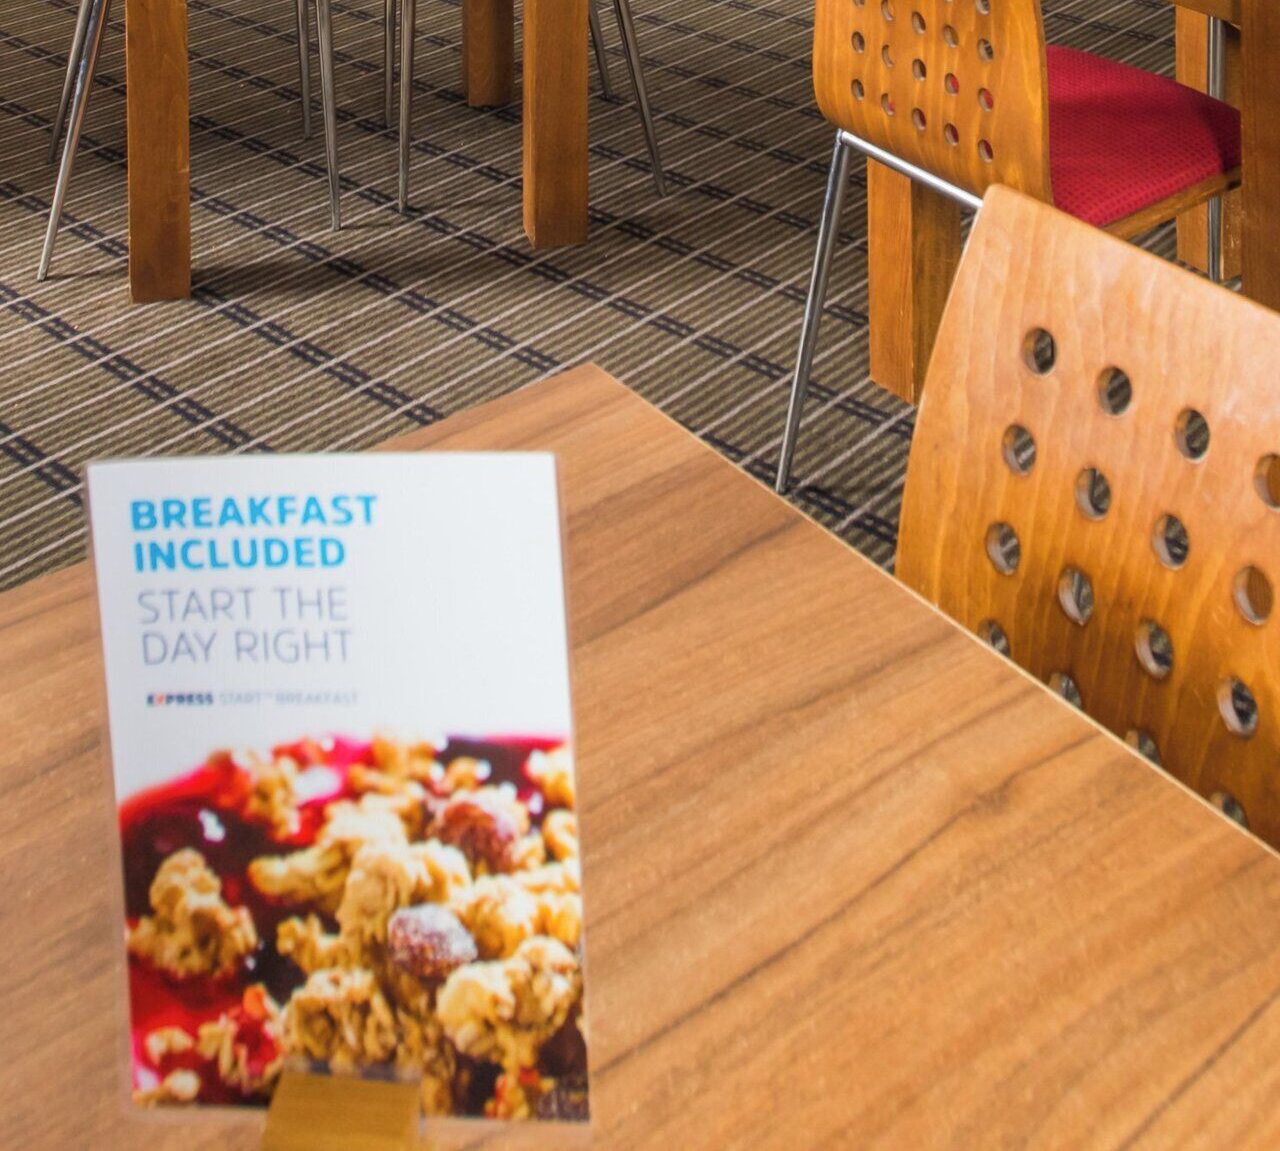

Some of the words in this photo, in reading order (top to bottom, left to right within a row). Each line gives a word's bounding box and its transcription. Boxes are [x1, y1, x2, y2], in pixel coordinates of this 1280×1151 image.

[131, 495, 377, 531] BREAKFAST
[134, 538, 345, 572] INCLUDED
[137, 587, 255, 624] START
[273, 587, 349, 621] THE
[142, 630, 217, 665] DAY
[235, 628, 351, 663] RIGHT
[146, 693, 214, 706] EXPRESS
[275, 691, 358, 705] BREAKFAST
